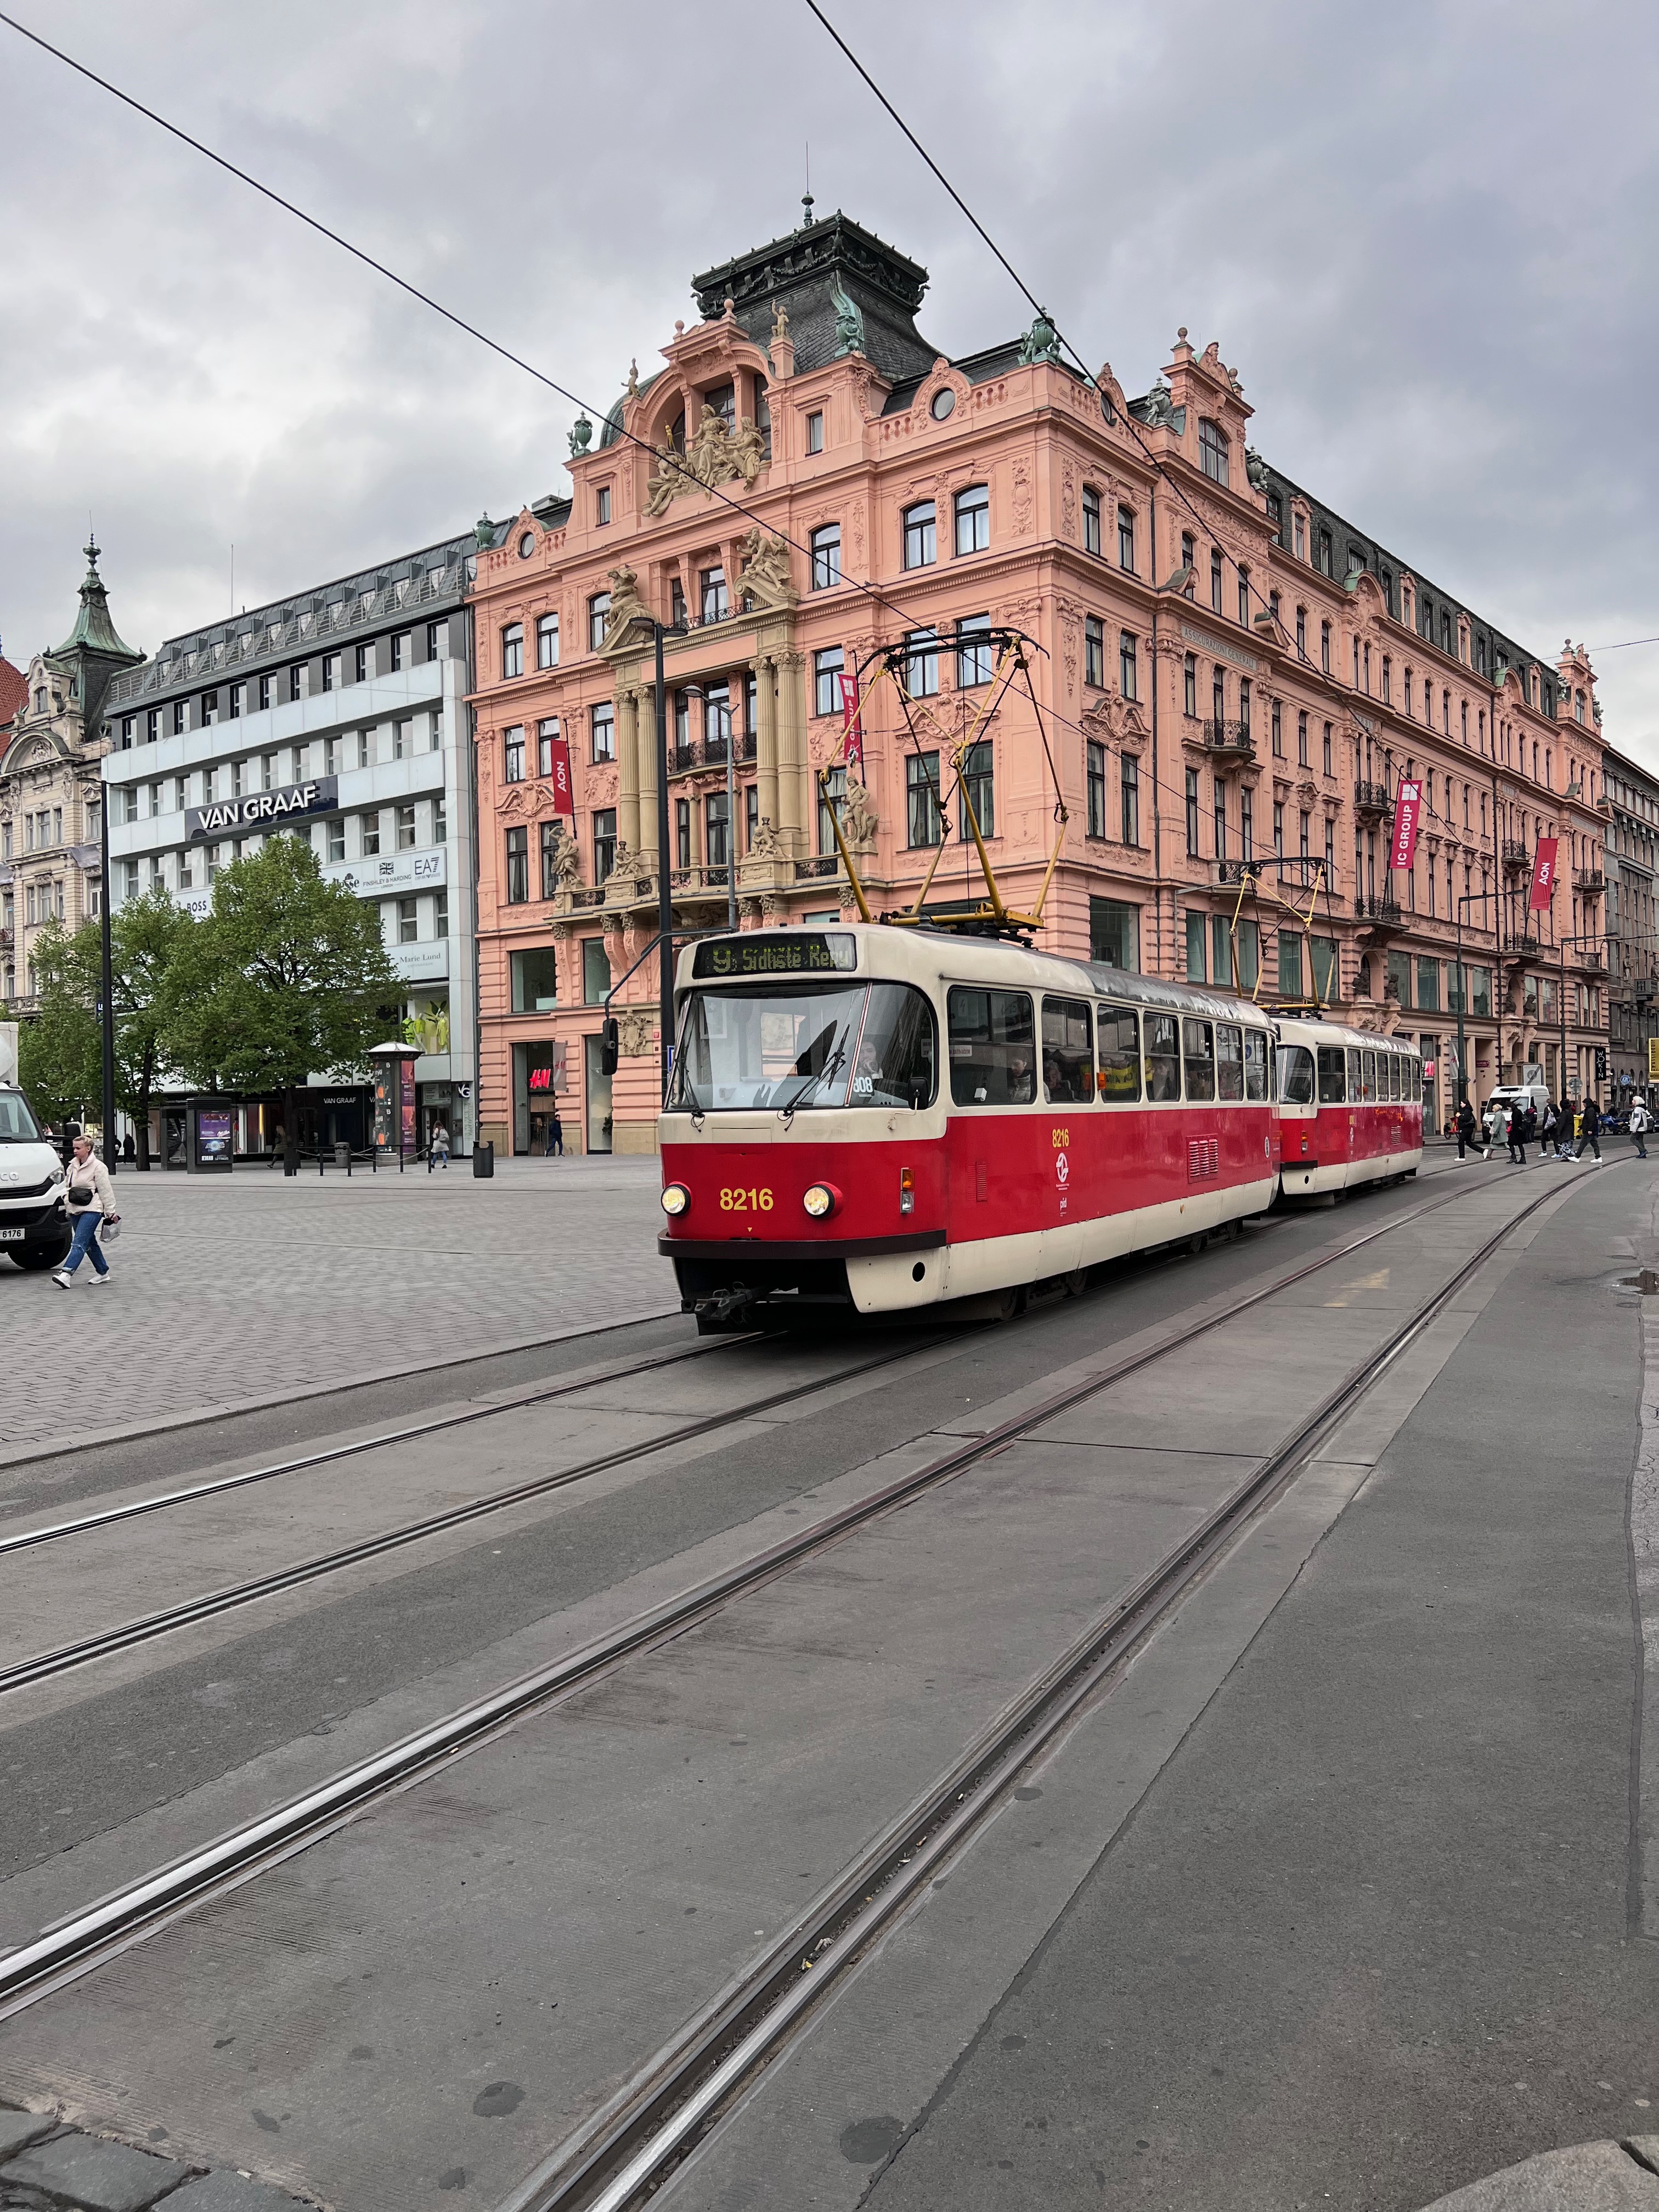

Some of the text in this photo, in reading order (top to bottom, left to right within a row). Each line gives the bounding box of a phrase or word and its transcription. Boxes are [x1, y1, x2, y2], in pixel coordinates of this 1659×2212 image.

[1184, 628, 1254, 668] ASSICURAZIONI GENERALI
[556, 761, 567, 793] AON
[198, 785, 316, 829] VAN GRAAF
[1397, 805, 1413, 865] IC GROUP
[415, 856, 439, 875] EA7
[1538, 862, 1550, 885] AON
[390, 874, 411, 883] HARDING
[187, 900, 207, 912] BOSS
[400, 952, 441, 963] Marie Lund
[853, 1076, 873, 1093] 808
[1052, 1128, 1069, 1148] 8216
[720, 1188, 774, 1211] 8216
[2, 1229, 21, 1238] 6176
